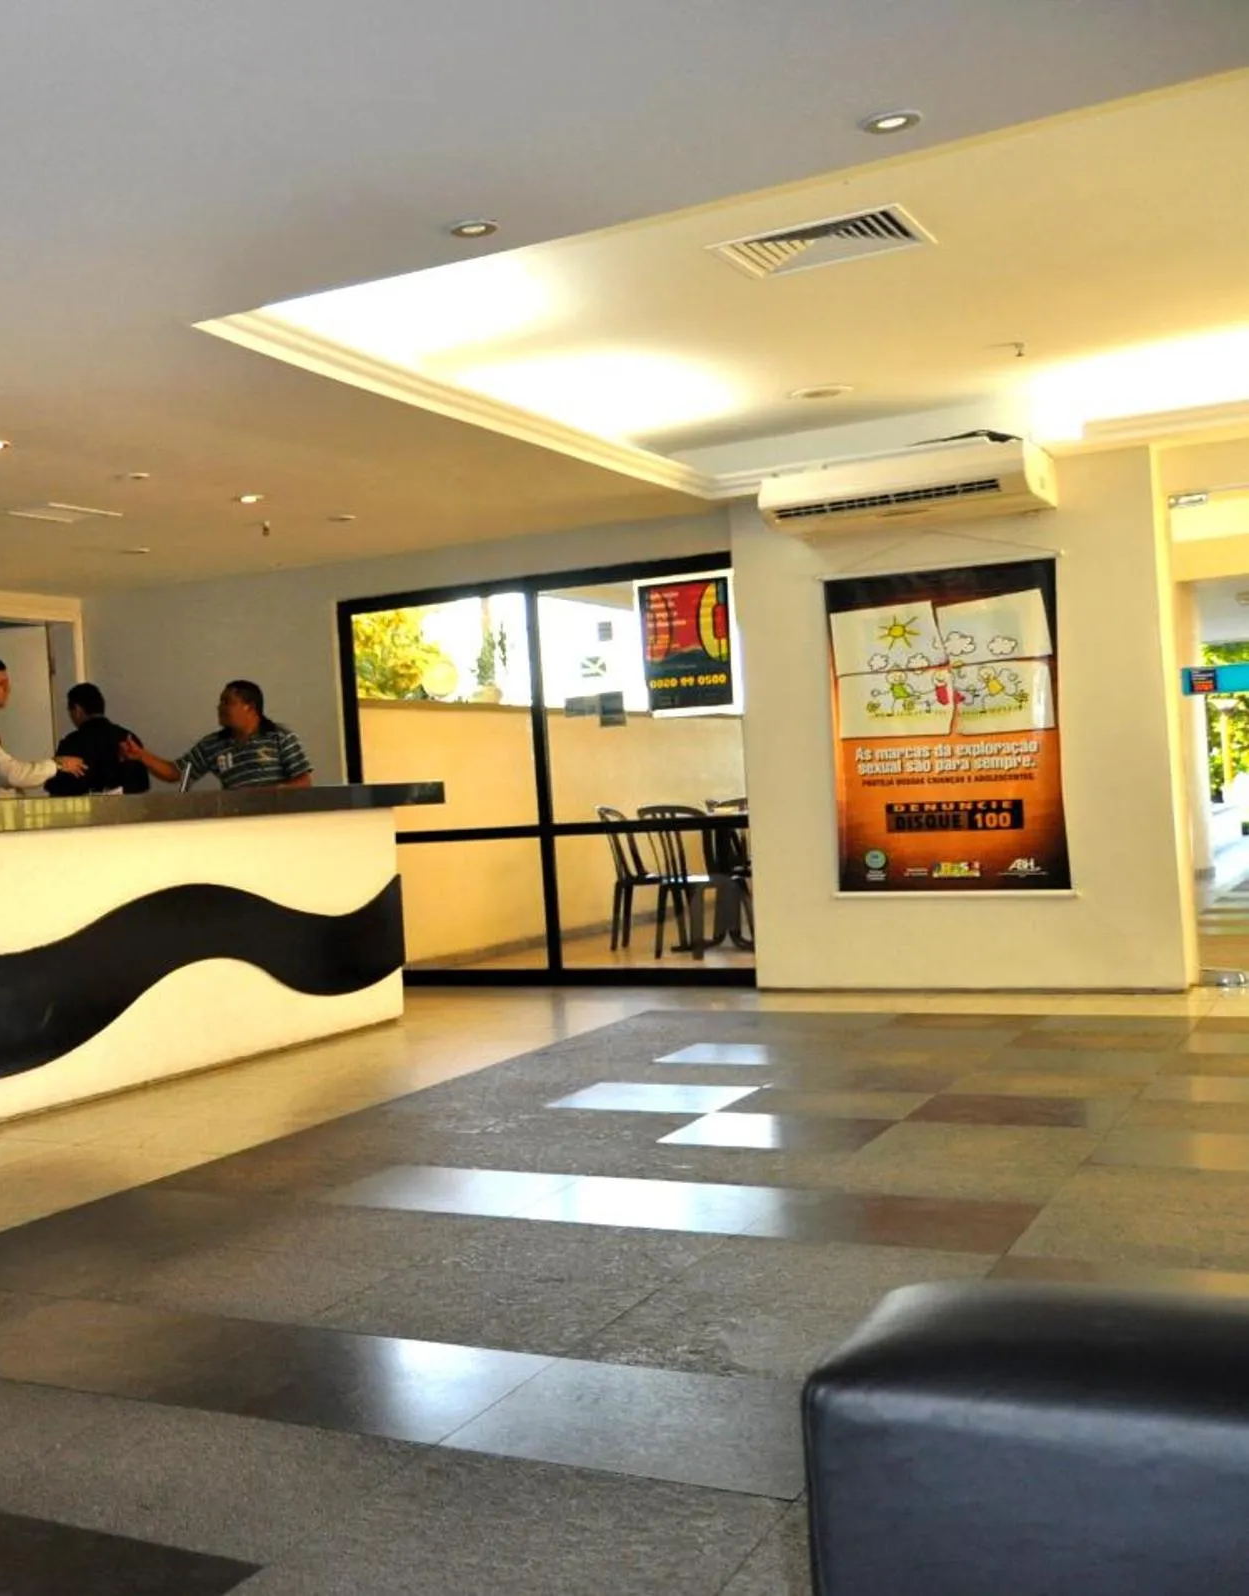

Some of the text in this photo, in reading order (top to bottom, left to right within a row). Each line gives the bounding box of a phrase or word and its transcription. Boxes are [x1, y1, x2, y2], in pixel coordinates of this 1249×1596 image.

[855, 741, 1038, 762] As marcas da exploração
[857, 760, 902, 775] sexual
[904, 757, 932, 773] são
[934, 757, 970, 774] para
[893, 800, 1013, 813] DENUNCIE
[894, 812, 1011, 829] DISQUE 100
